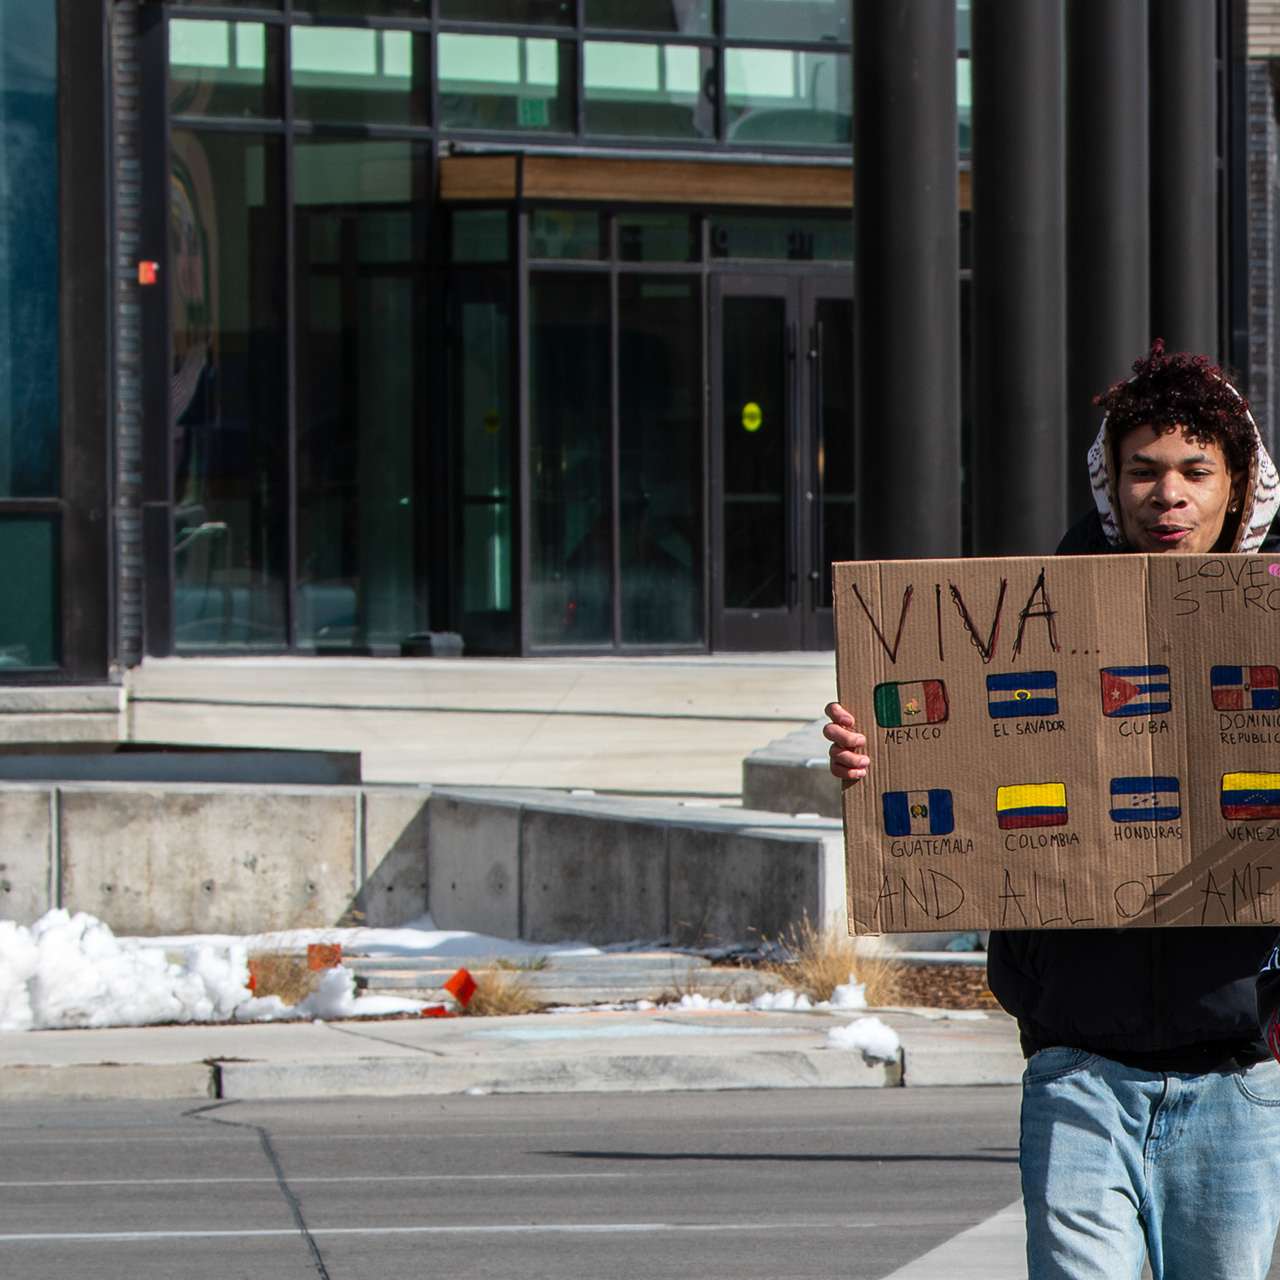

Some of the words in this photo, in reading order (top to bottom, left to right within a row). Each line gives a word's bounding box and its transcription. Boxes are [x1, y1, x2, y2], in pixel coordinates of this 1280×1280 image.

[1176, 560, 1270, 588] LOVE
[884, 727, 942, 745] MEXICO
[993, 724, 1009, 738] EL
[1016, 719, 1067, 736] SAVADOR
[1118, 719, 1170, 737] CUBA
[1004, 832, 1080, 852] COLOMBIA
[1113, 825, 1183, 842] HONDURAS
[890, 838, 974, 858] GUATEMALA
[873, 867, 965, 928] AND
[998, 868, 1095, 926] ALL
[1113, 872, 1175, 924] OF
